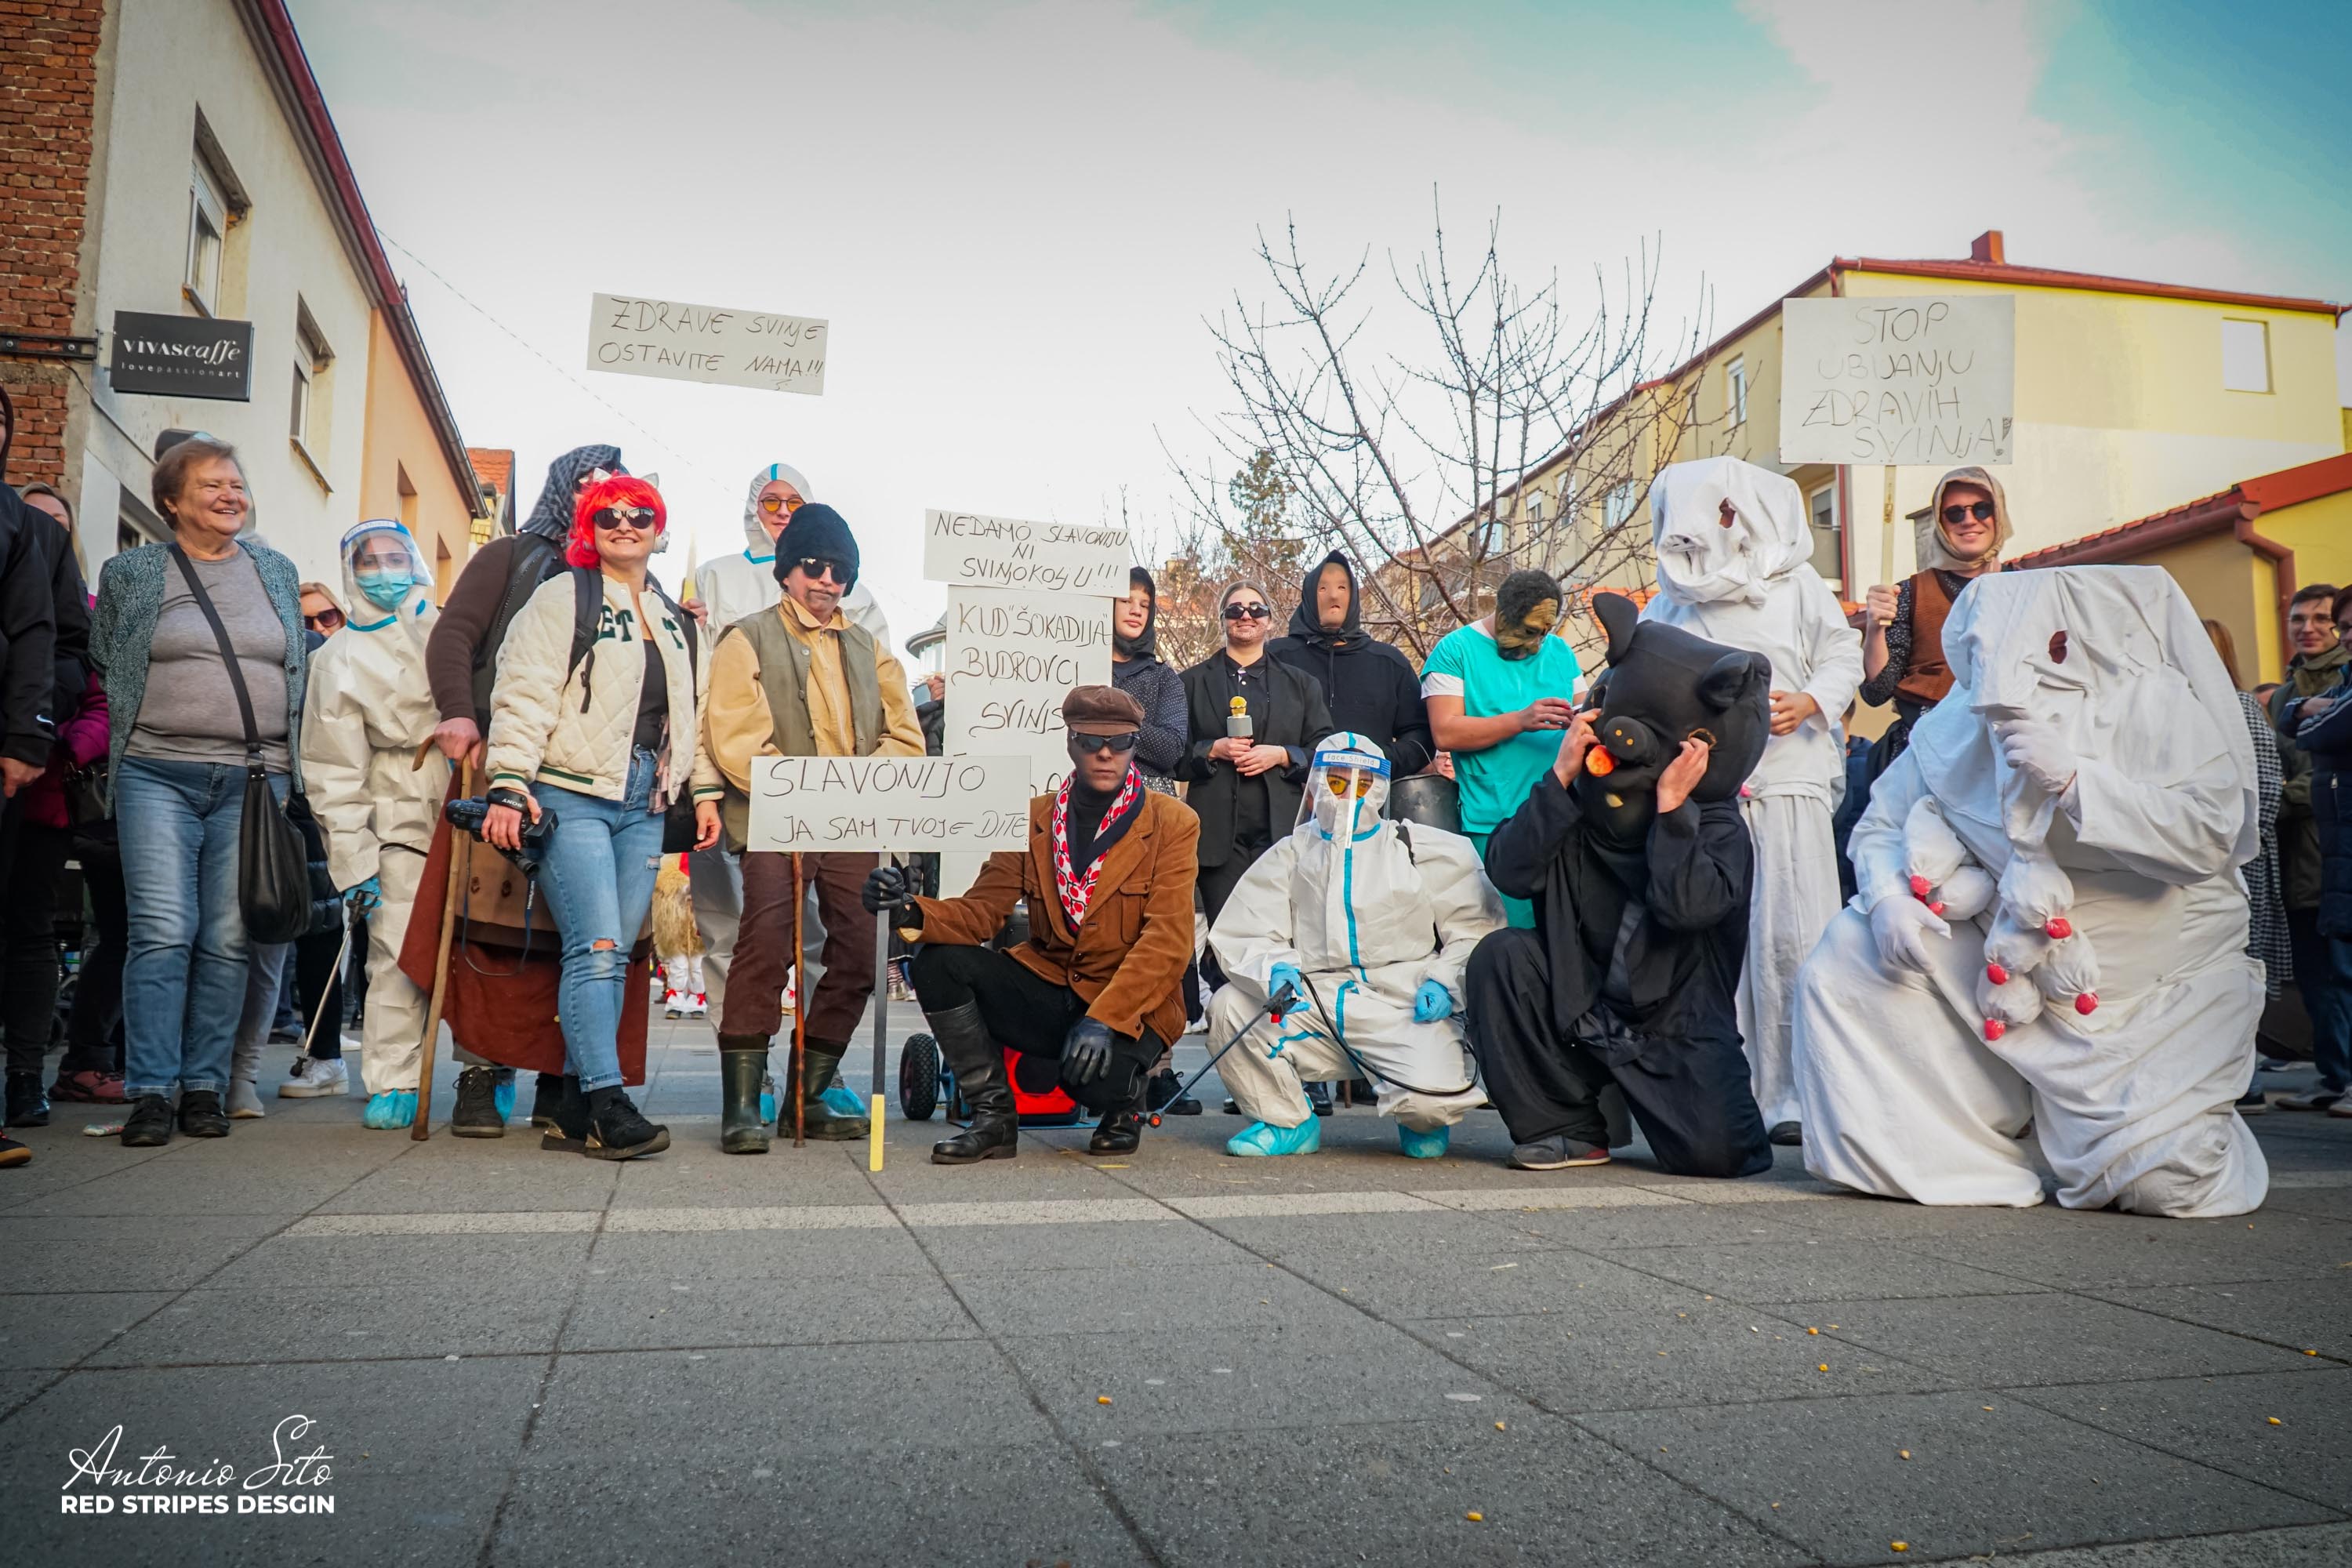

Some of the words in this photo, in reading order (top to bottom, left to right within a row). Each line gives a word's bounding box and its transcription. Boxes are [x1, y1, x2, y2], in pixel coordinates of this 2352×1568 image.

[611, 297, 734, 333] ZDRAVE
[746, 316, 826, 347] SVINJE
[1856, 302, 1949, 344] STOP
[598, 342, 725, 371] OSTAVITE
[745, 355, 823, 377] NAMA!!!
[1802, 387, 1961, 426] ZDRAVIH
[935, 512, 1031, 542] NEDAMO
[1041, 525, 1128, 548] SLAVONIJU
[1012, 542, 1035, 560] NI
[959, 603, 1009, 637] KUD
[951, 647, 1079, 686] BUDROVCI
[968, 699, 1066, 738] SVINJS
[763, 759, 985, 798] SLAVONIJO
[502, 798, 524, 808] SONY
[770, 815, 815, 844] JA
[822, 816, 877, 840] SAM
[887, 818, 974, 838] TVOJE
